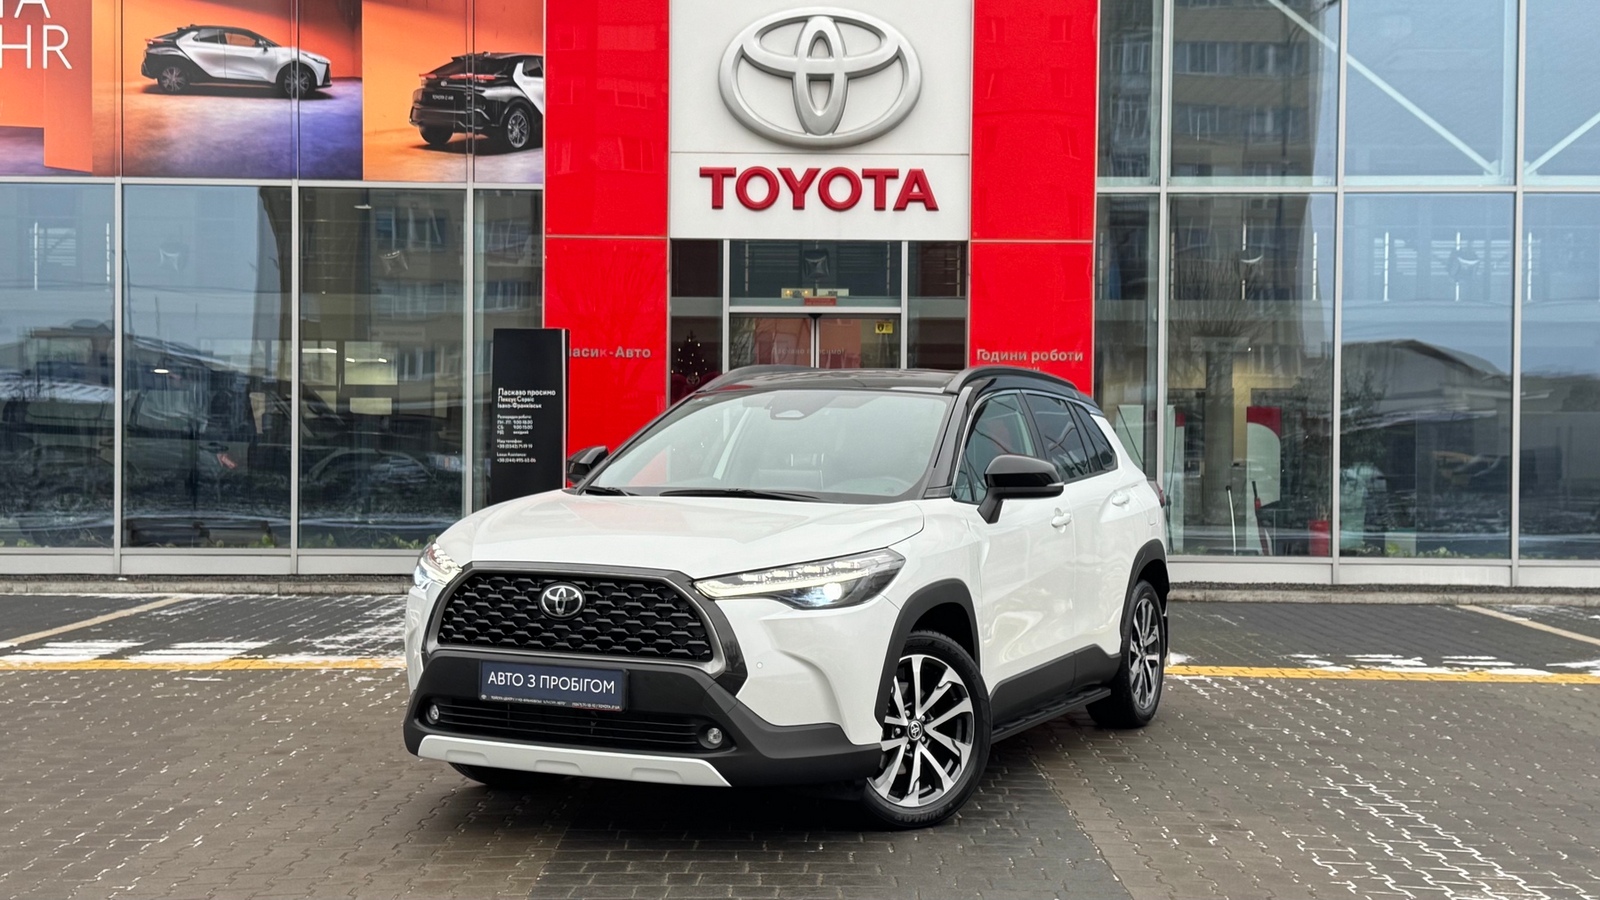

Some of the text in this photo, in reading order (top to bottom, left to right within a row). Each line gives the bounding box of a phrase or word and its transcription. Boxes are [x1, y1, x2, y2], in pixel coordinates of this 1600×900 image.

[700, 166, 939, 211] TOYOTA
[976, 349, 1083, 363] Години роботи
[527, 389, 556, 397] просимо
[487, 671, 615, 694] АВТО З ПРОБІГОМ
